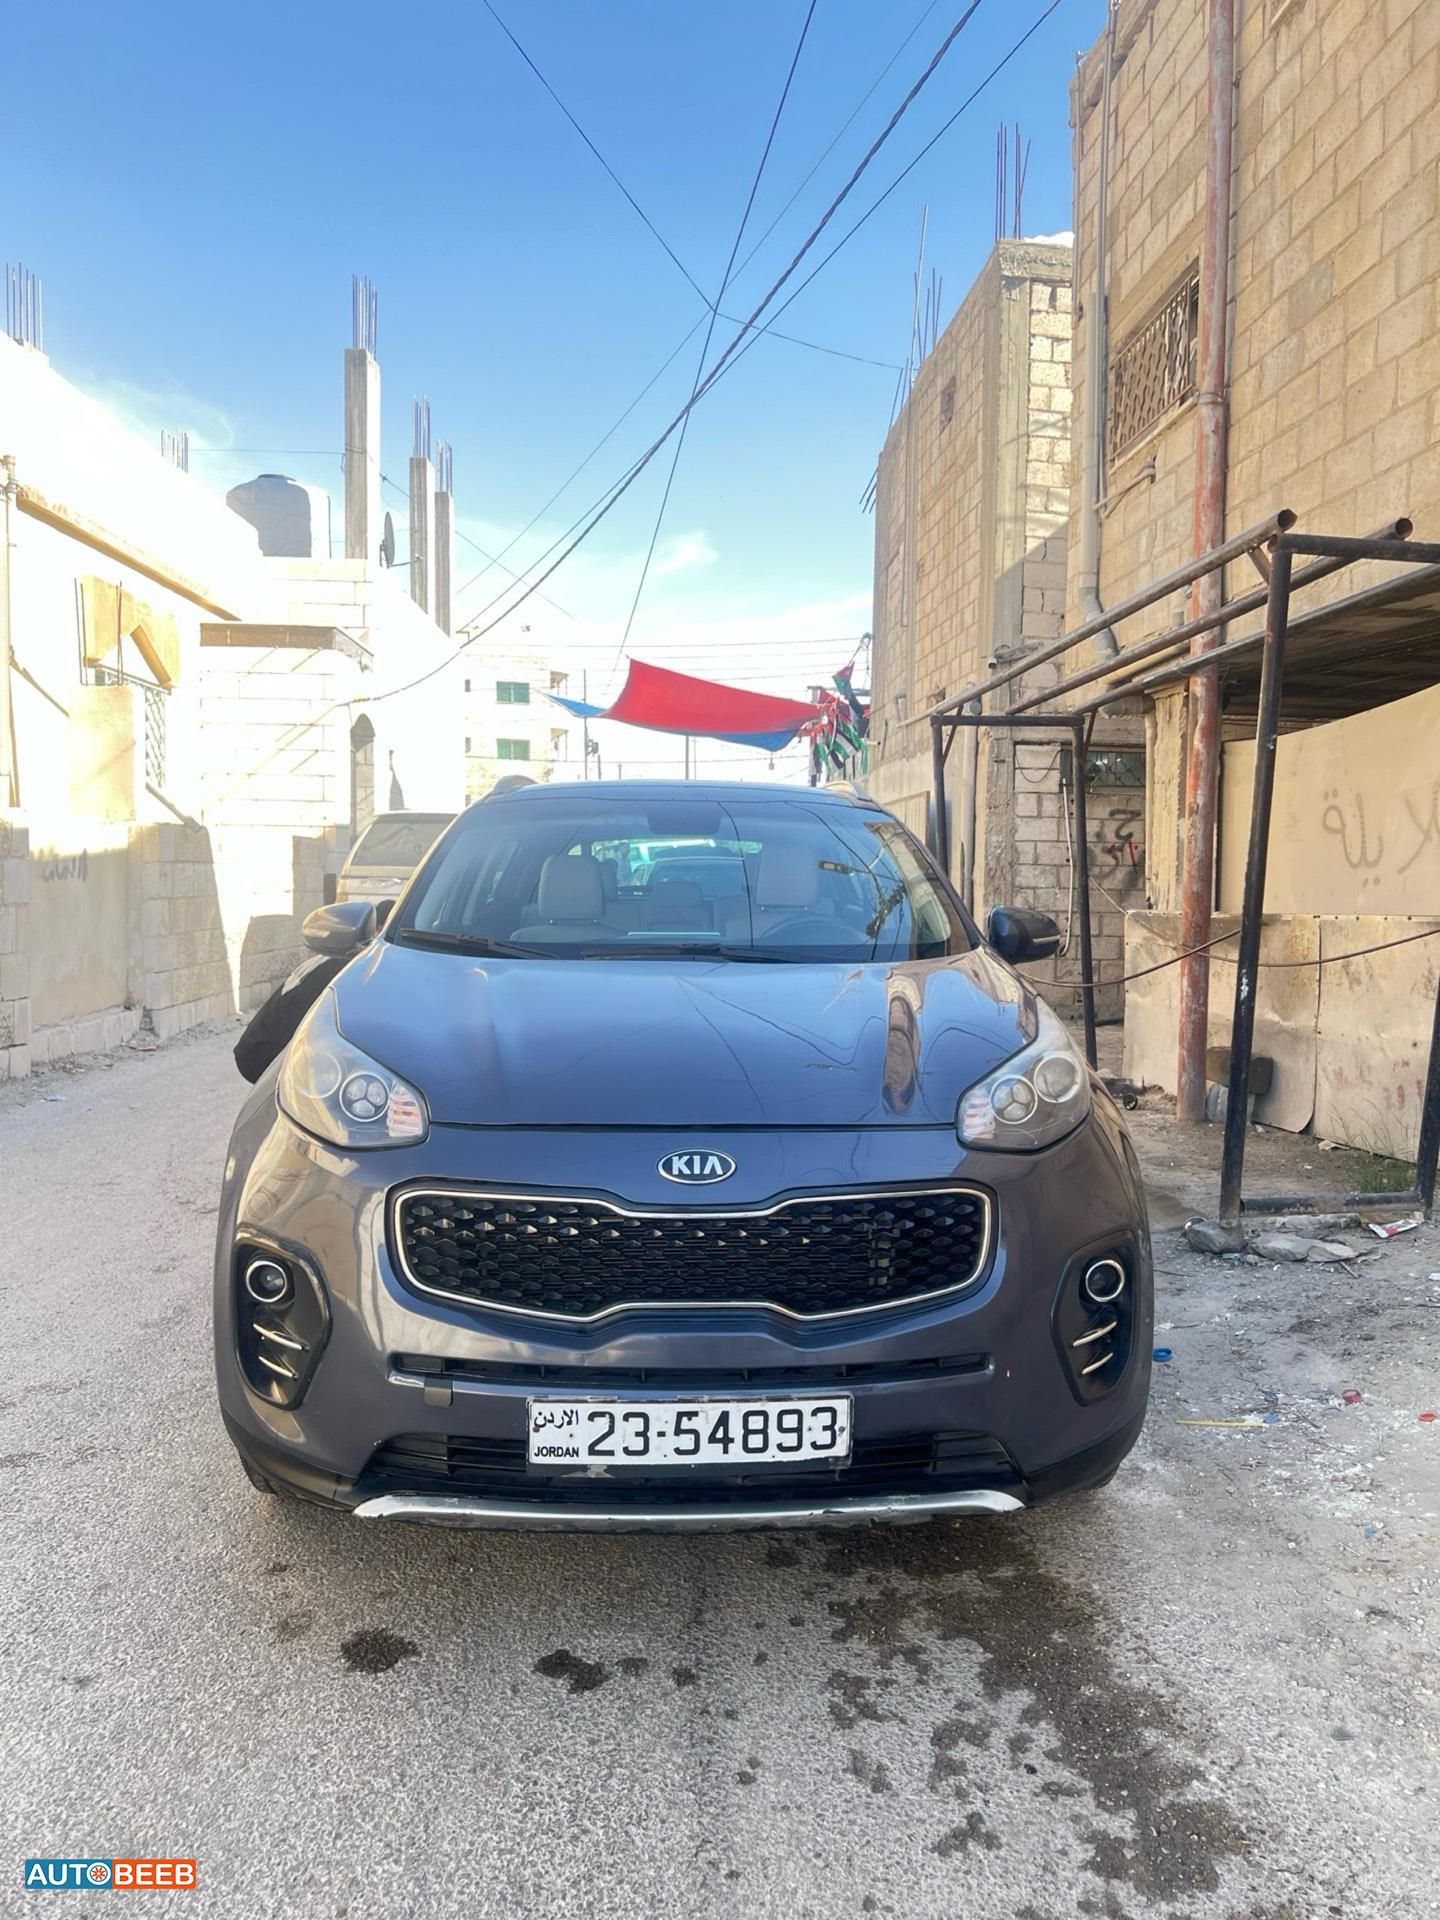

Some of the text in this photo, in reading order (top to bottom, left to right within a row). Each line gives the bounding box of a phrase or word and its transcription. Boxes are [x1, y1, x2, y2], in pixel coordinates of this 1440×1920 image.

[671, 1155, 724, 1175] KIA
[533, 1409, 579, 1430] الاردن
[587, 1406, 838, 1457] 23-54893
[534, 1446, 579, 1458] JORDAN
